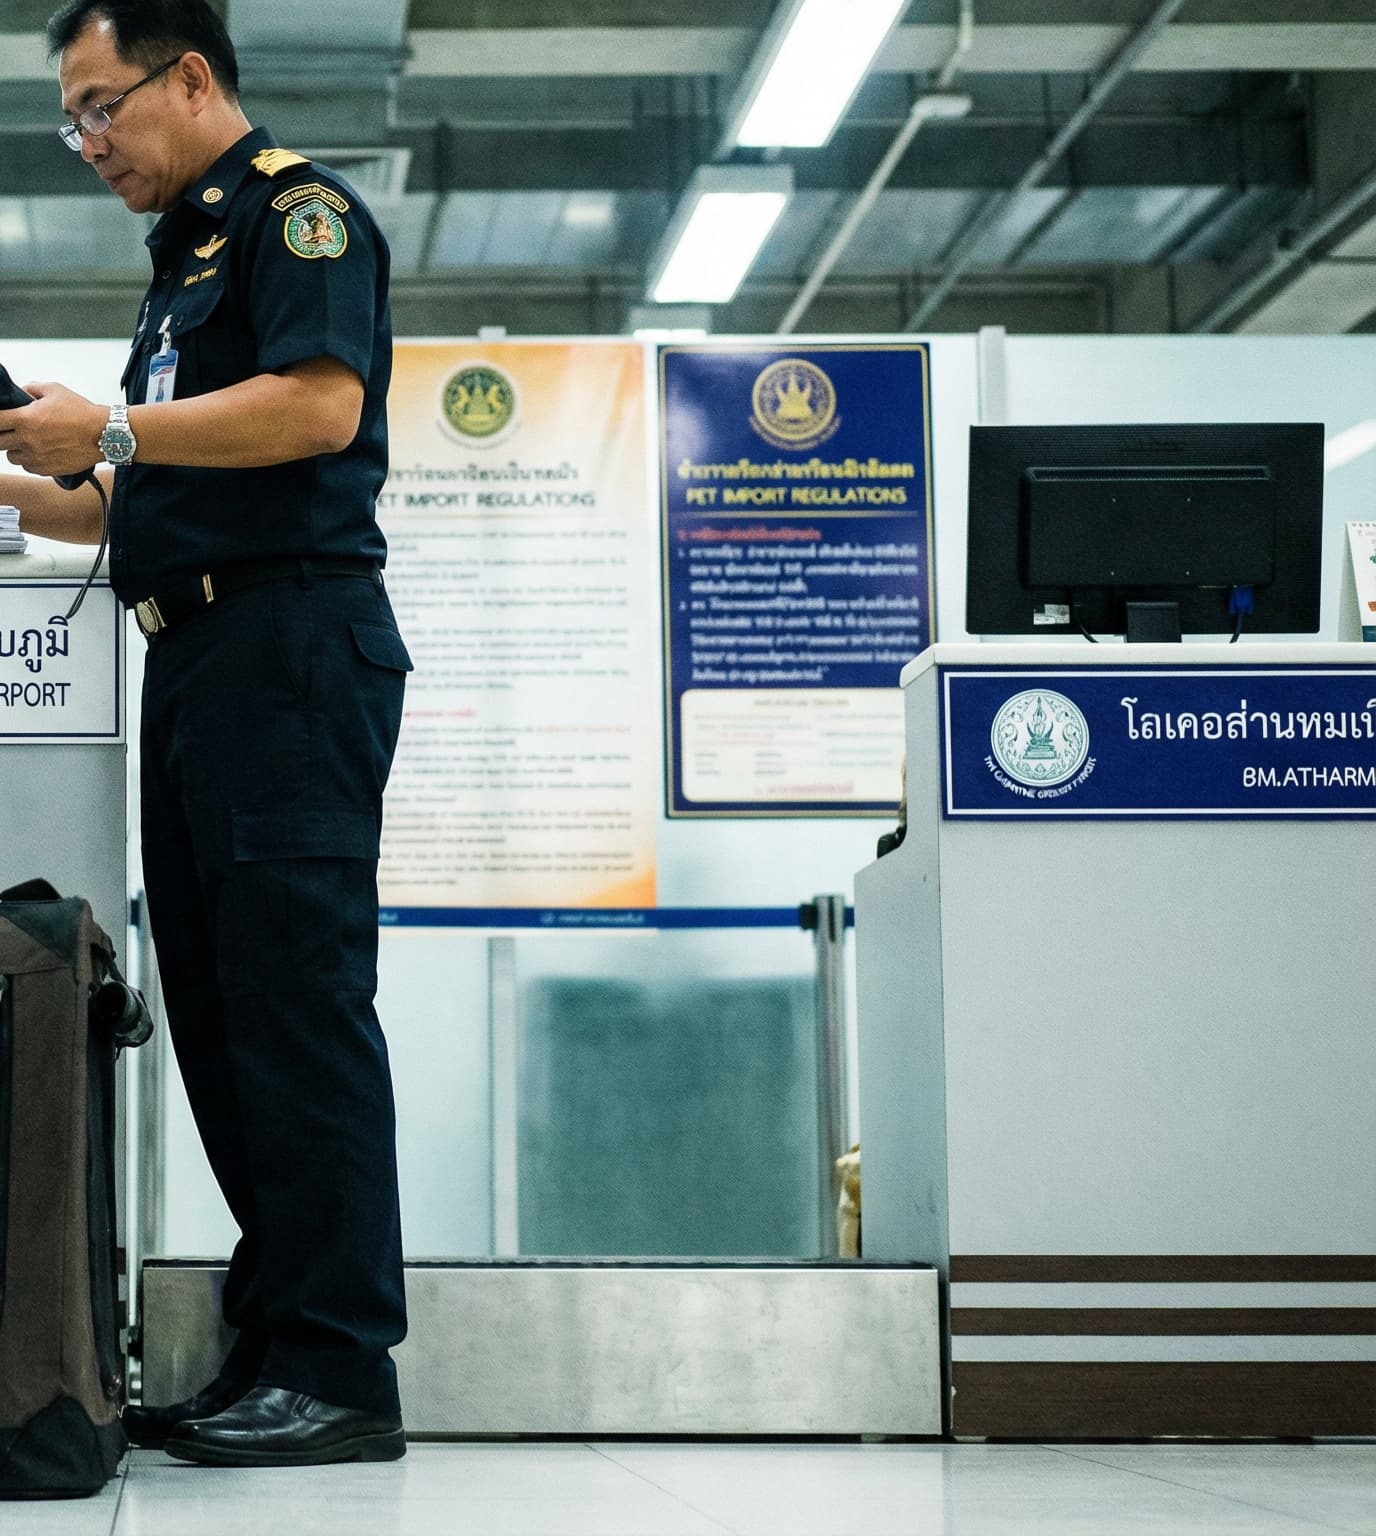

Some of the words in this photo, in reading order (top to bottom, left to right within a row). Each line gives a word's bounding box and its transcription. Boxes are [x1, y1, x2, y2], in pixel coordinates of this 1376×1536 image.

[404, 492, 469, 508] IMPORT
[476, 492, 596, 508] REGULATIONS
[686, 487, 717, 504] PET
[723, 487, 786, 504] IMPORT
[791, 486, 907, 504] REGULATIONS
